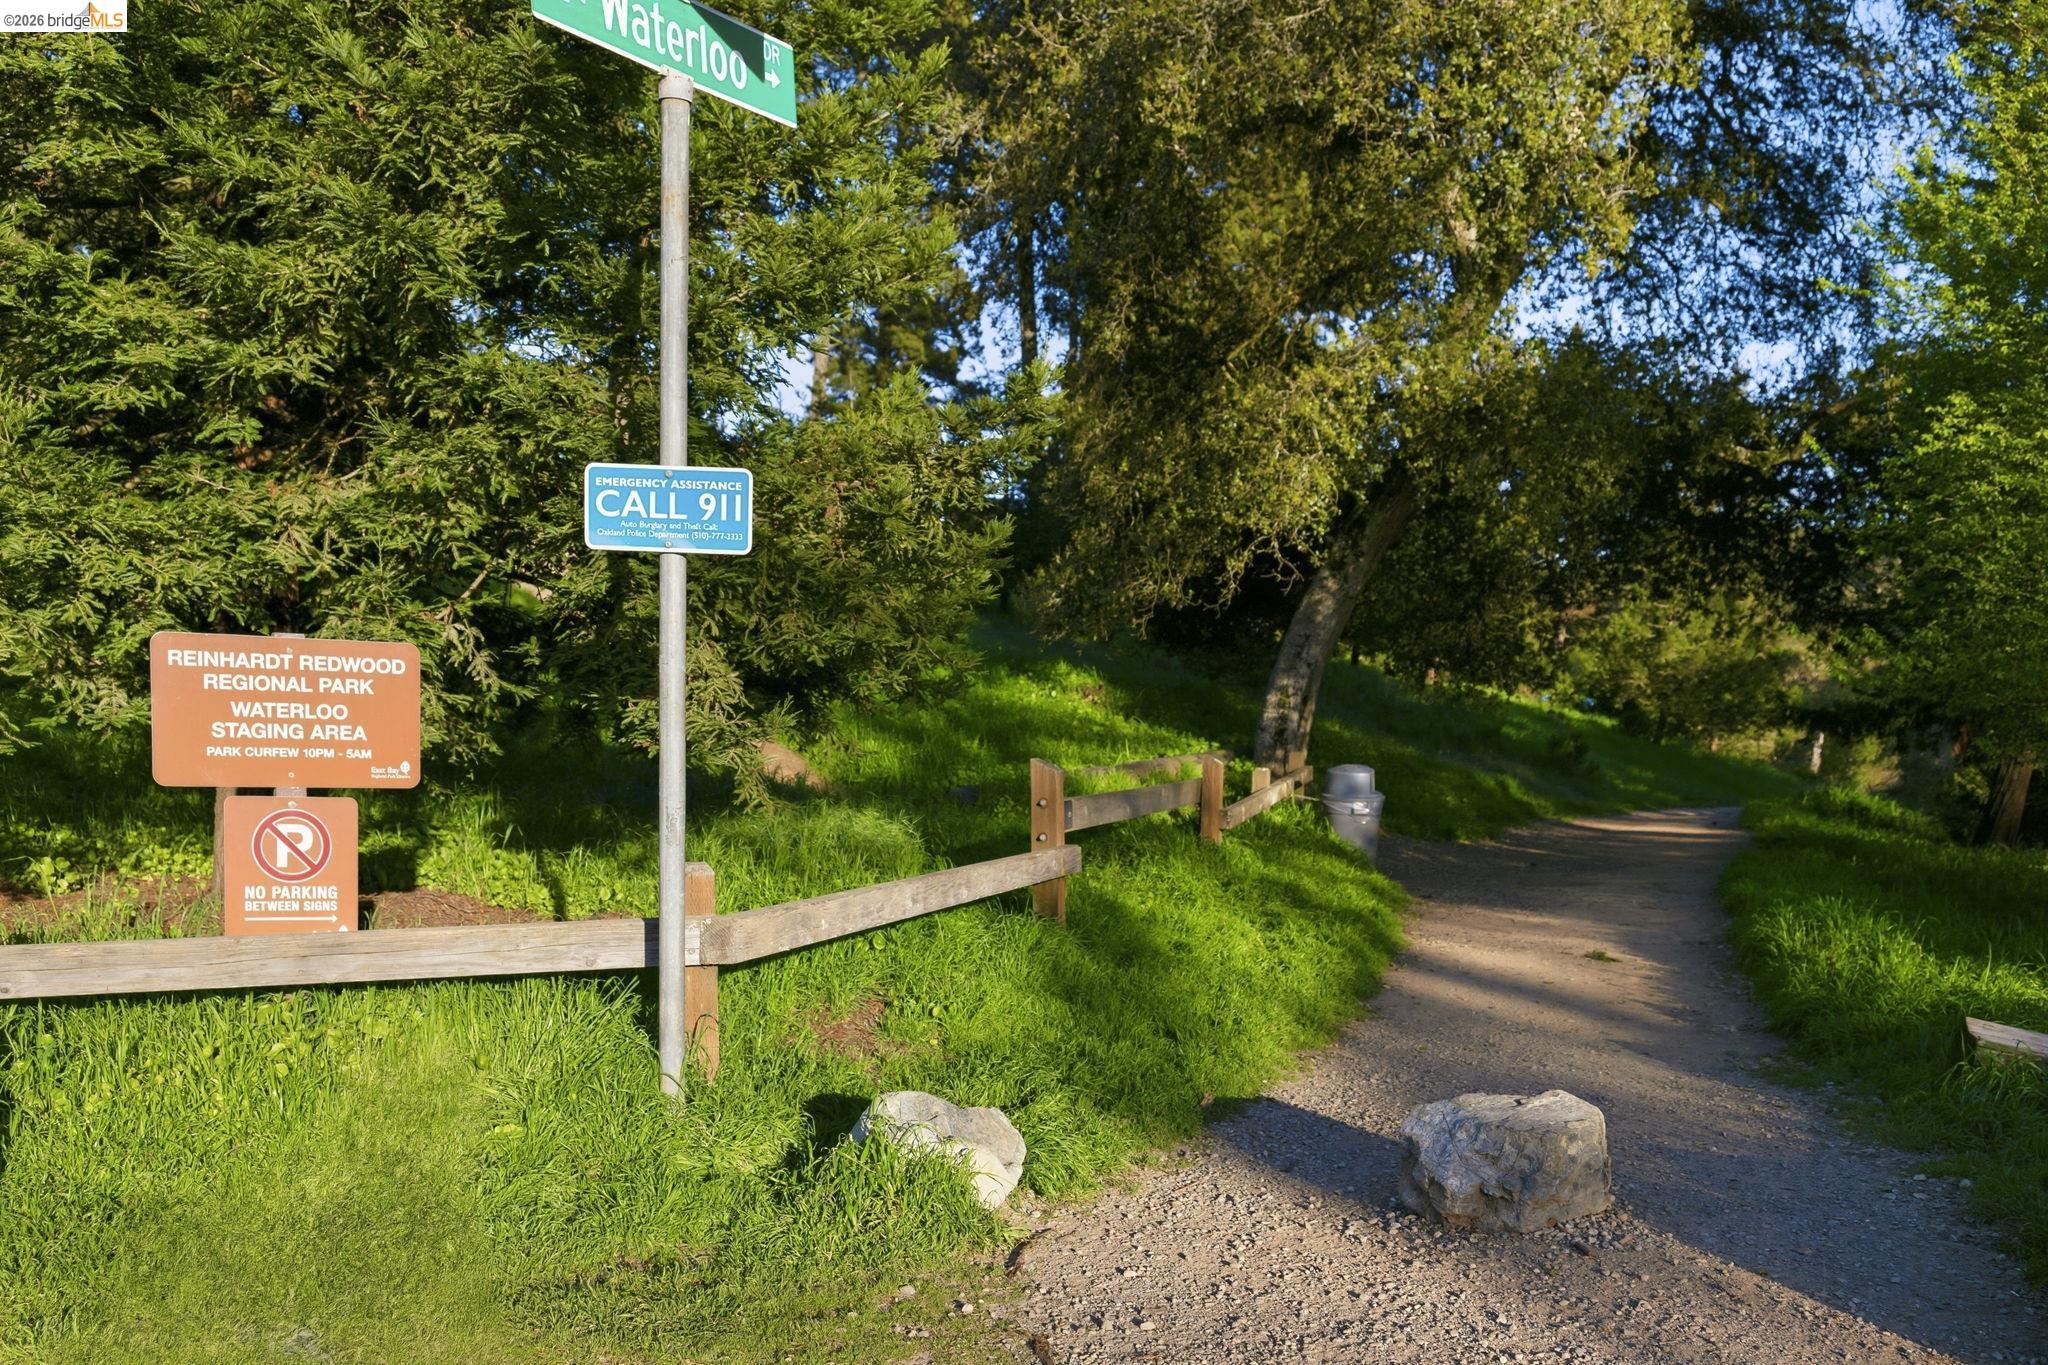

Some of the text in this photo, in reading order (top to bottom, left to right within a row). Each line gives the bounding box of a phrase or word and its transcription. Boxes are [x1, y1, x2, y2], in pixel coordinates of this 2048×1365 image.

[601, 0, 781, 89] Waterloo DR
[595, 476, 743, 491] EMERGENCY ASSISTANCE
[595, 489, 742, 522] CALL 911
[596, 528, 625, 537] Oakland
[626, 529, 647, 538] Police
[648, 530, 690, 540] Department
[620, 520, 638, 528] Auto
[639, 520, 667, 531] Burglary
[669, 522, 681, 530] and
[684, 522, 701, 530] Theft
[167, 649, 406, 675] REINHARDT REDWOOD
[203, 674, 374, 695] REGIONAL PARK
[231, 701, 349, 720] WATERLOO
[211, 721, 368, 741] STAGING AREA
[206, 746, 241, 757] PARK
[244, 747, 299, 758] CURFEW
[303, 748, 334, 759] 10PM
[346, 749, 372, 760] 5AM
[244, 885, 338, 899] NO PARKING
[244, 900, 338, 912] BETWEEN SIGNS
